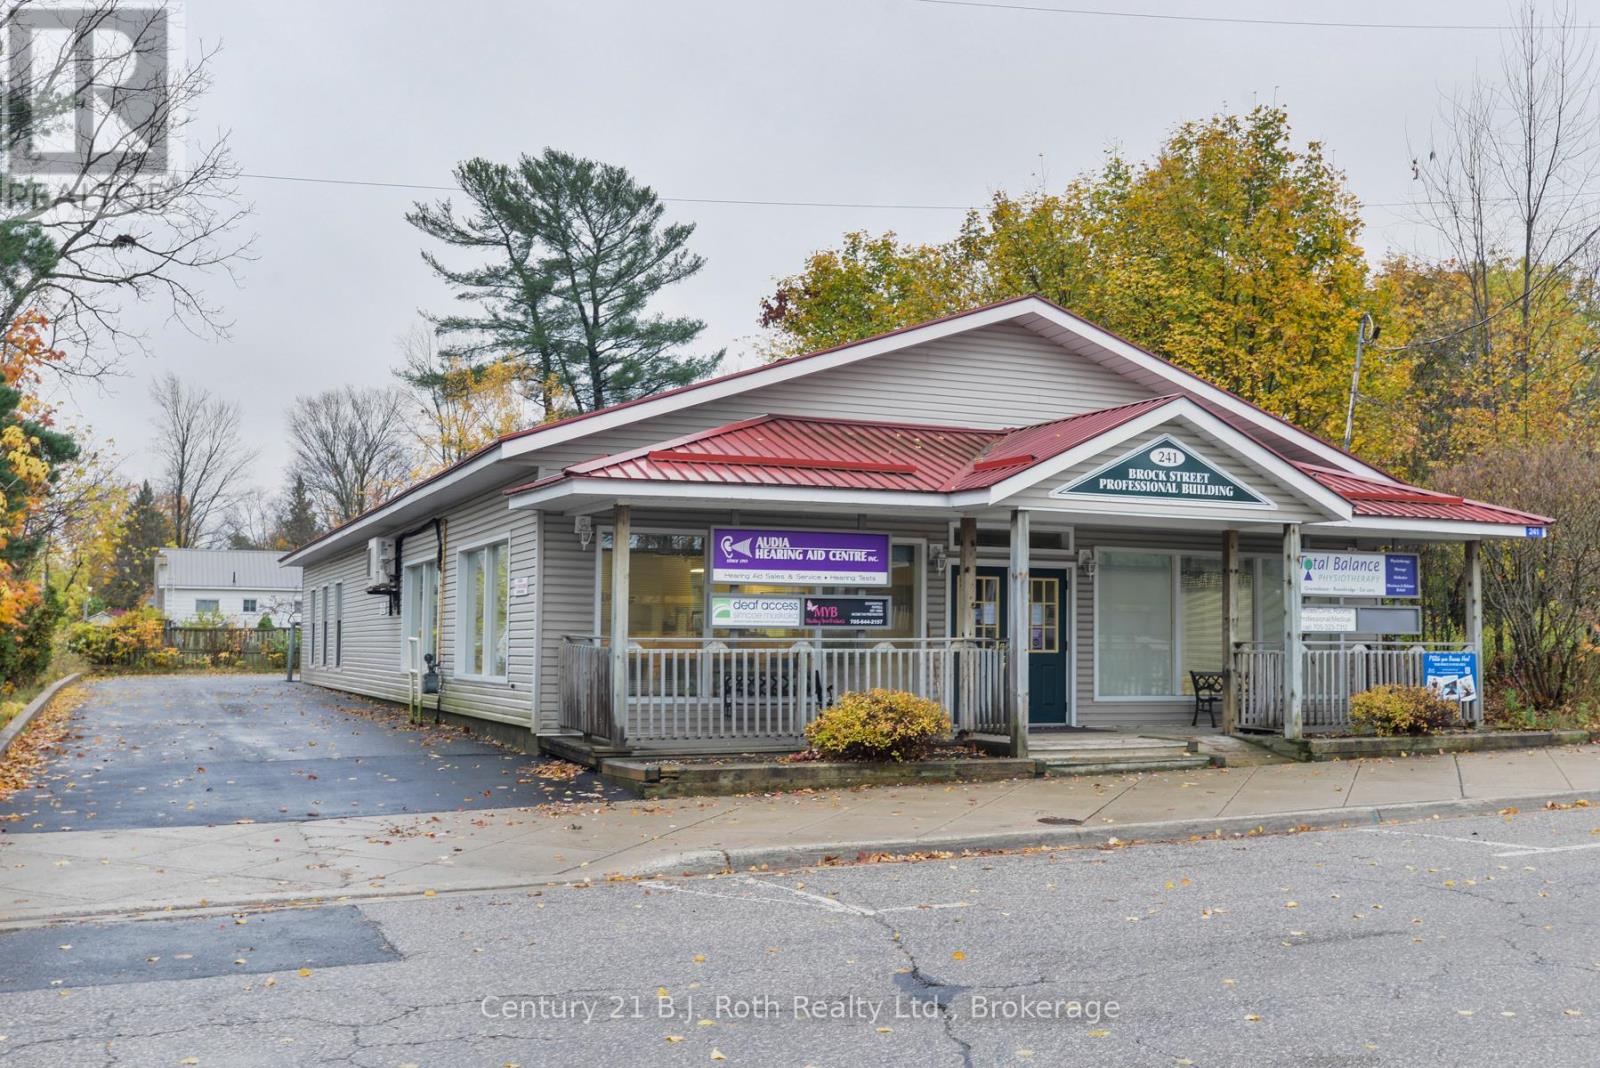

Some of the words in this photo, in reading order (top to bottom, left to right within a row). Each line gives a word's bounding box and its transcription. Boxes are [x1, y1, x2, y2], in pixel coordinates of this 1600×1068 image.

[1158, 451, 1178, 464] 241
[1128, 468, 1167, 481] BROCK
[1169, 471, 1210, 483] STREET
[1099, 478, 1179, 494] PROFESSIONAL
[1182, 484, 1234, 497] BUILDING
[755, 536, 790, 548] AUDIA
[755, 548, 803, 560] HEARING
[806, 549, 826, 561] AID
[829, 550, 867, 562] CENTRE
[1333, 556, 1380, 572] Balance
[1318, 573, 1381, 583] PHYSIOTHERAPY
[733, 600, 759, 610] deaf
[761, 601, 799, 610] access
[815, 606, 838, 617] MYB
